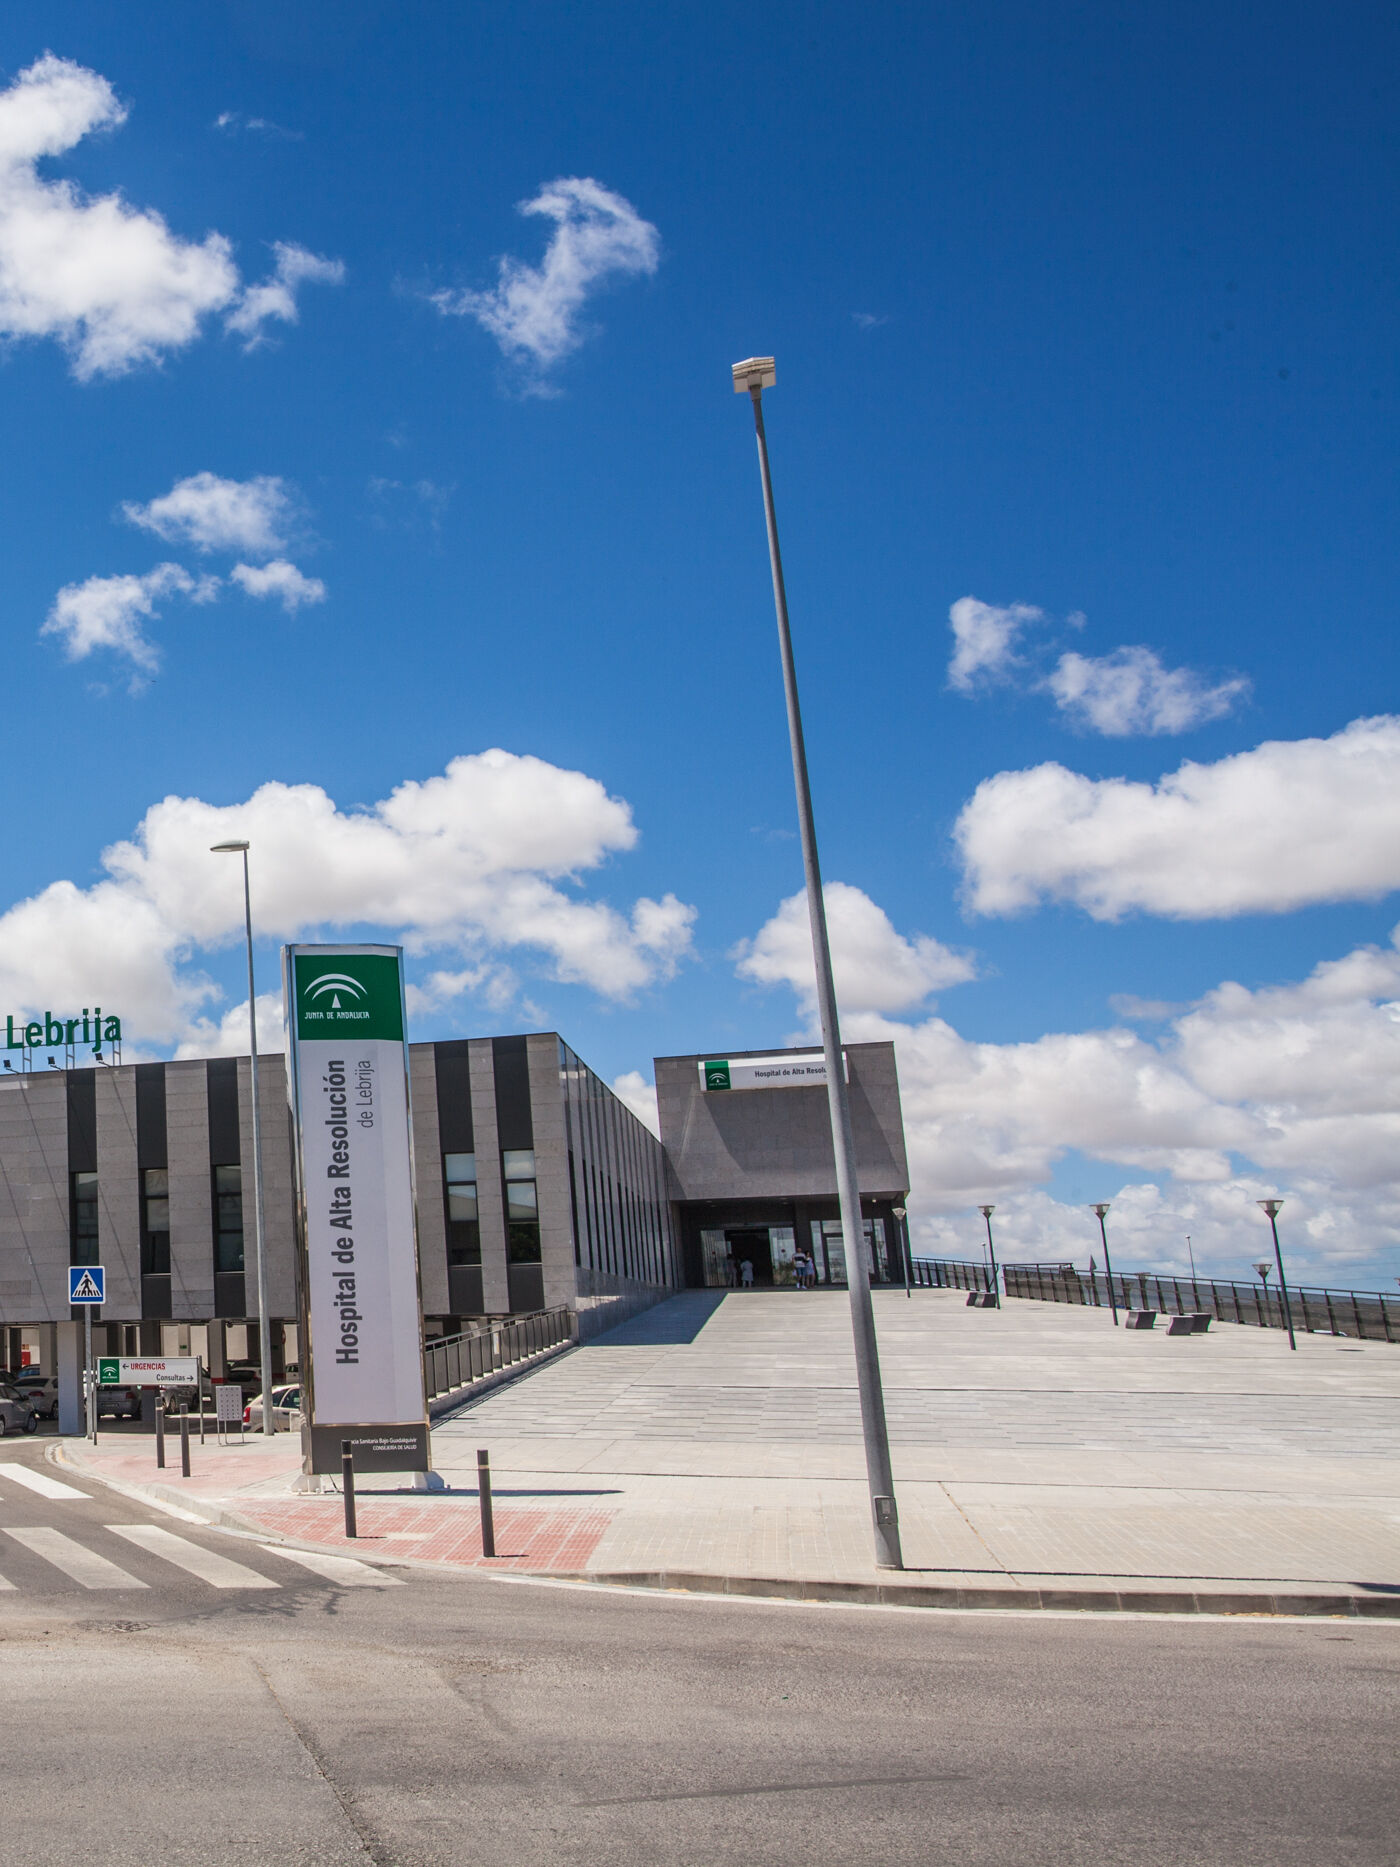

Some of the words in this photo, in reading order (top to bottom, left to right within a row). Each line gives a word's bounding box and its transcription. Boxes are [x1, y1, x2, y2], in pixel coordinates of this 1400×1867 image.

[7, 1007, 122, 1052] Lebrija
[305, 1011, 324, 1019] JUNTA
[326, 1011, 334, 1019] DE
[354, 1060, 374, 1106] Lebrija
[754, 1069, 781, 1077] Hospital
[323, 1060, 350, 1178] Resolución
[356, 1111, 374, 1128] de
[329, 1186, 353, 1230] Alta
[331, 1237, 354, 1264] de
[332, 1272, 363, 1363] Hospital
